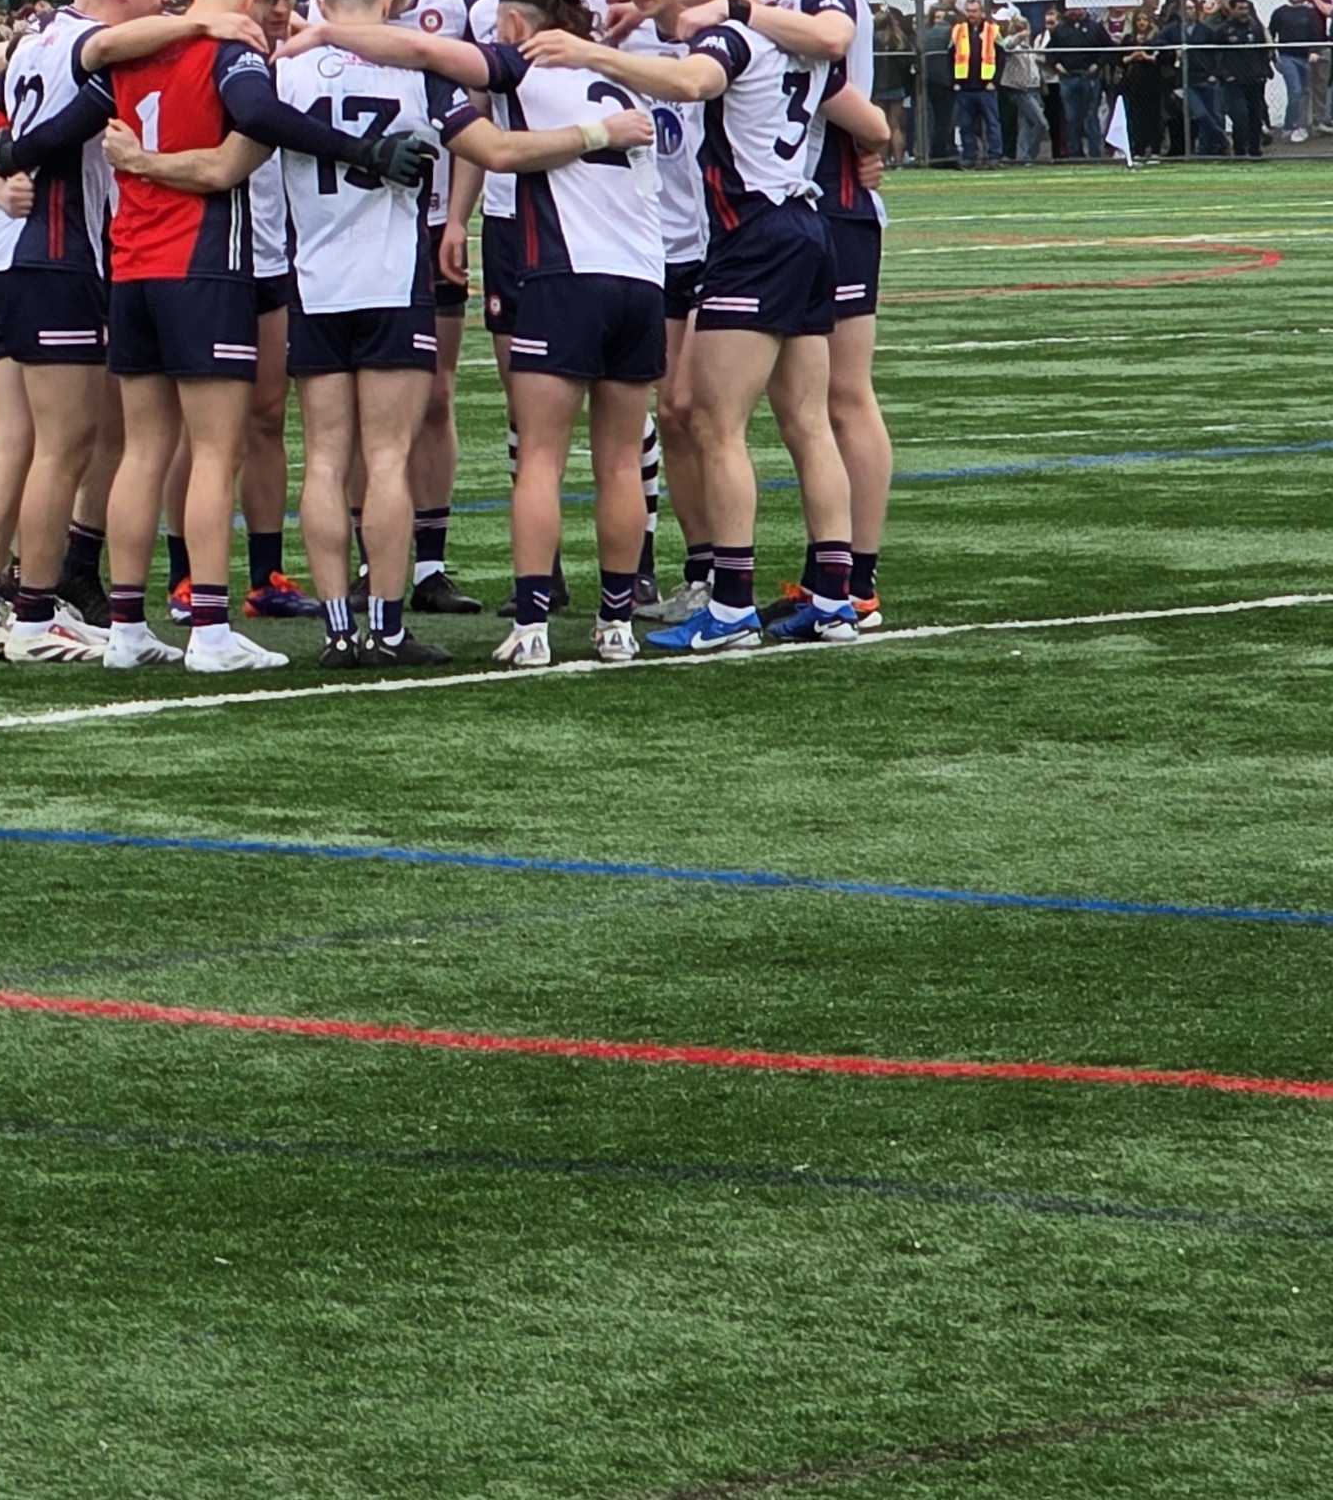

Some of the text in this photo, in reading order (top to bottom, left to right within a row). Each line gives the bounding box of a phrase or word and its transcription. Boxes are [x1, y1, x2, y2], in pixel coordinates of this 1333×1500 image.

[134, 90, 161, 153] 1
[299, 96, 402, 195] 13
[774, 71, 811, 161] 3
